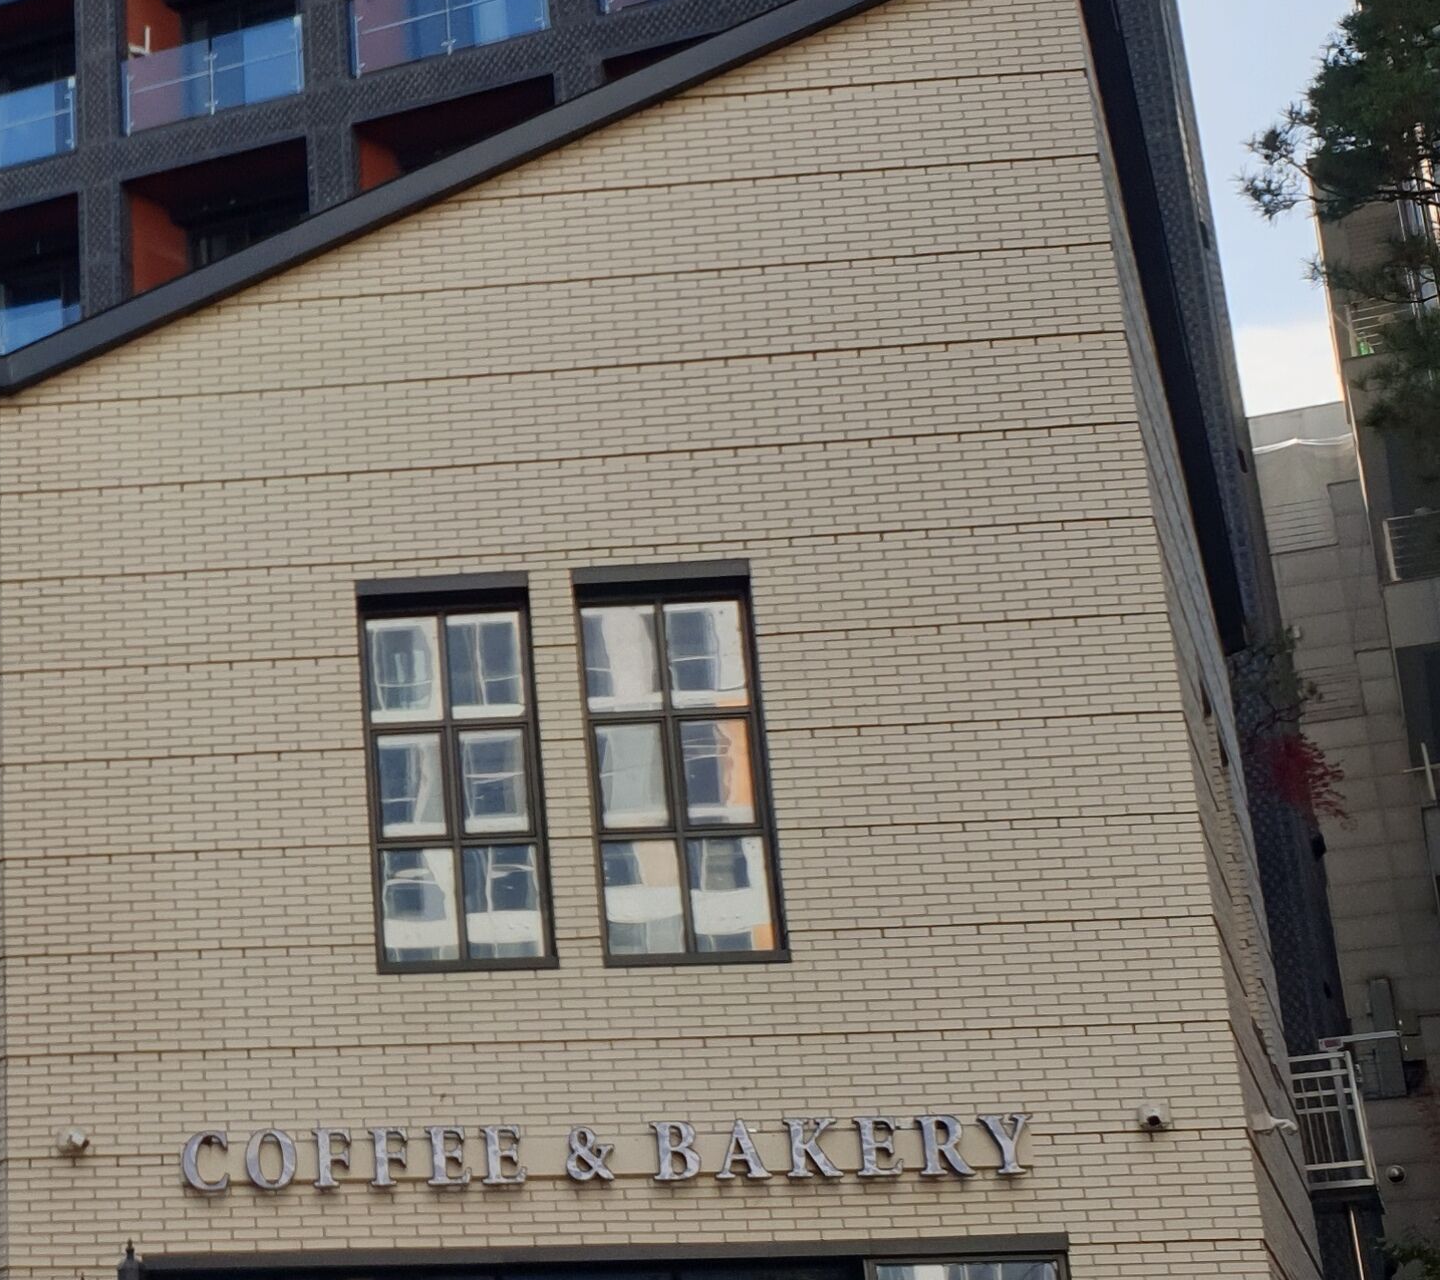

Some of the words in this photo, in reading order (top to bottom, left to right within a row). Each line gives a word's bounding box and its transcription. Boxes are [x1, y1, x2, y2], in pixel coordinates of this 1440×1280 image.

[181, 1124, 528, 1192] COFFEE
[565, 1125, 615, 1182] &
[649, 1113, 1033, 1182] BAKERY
